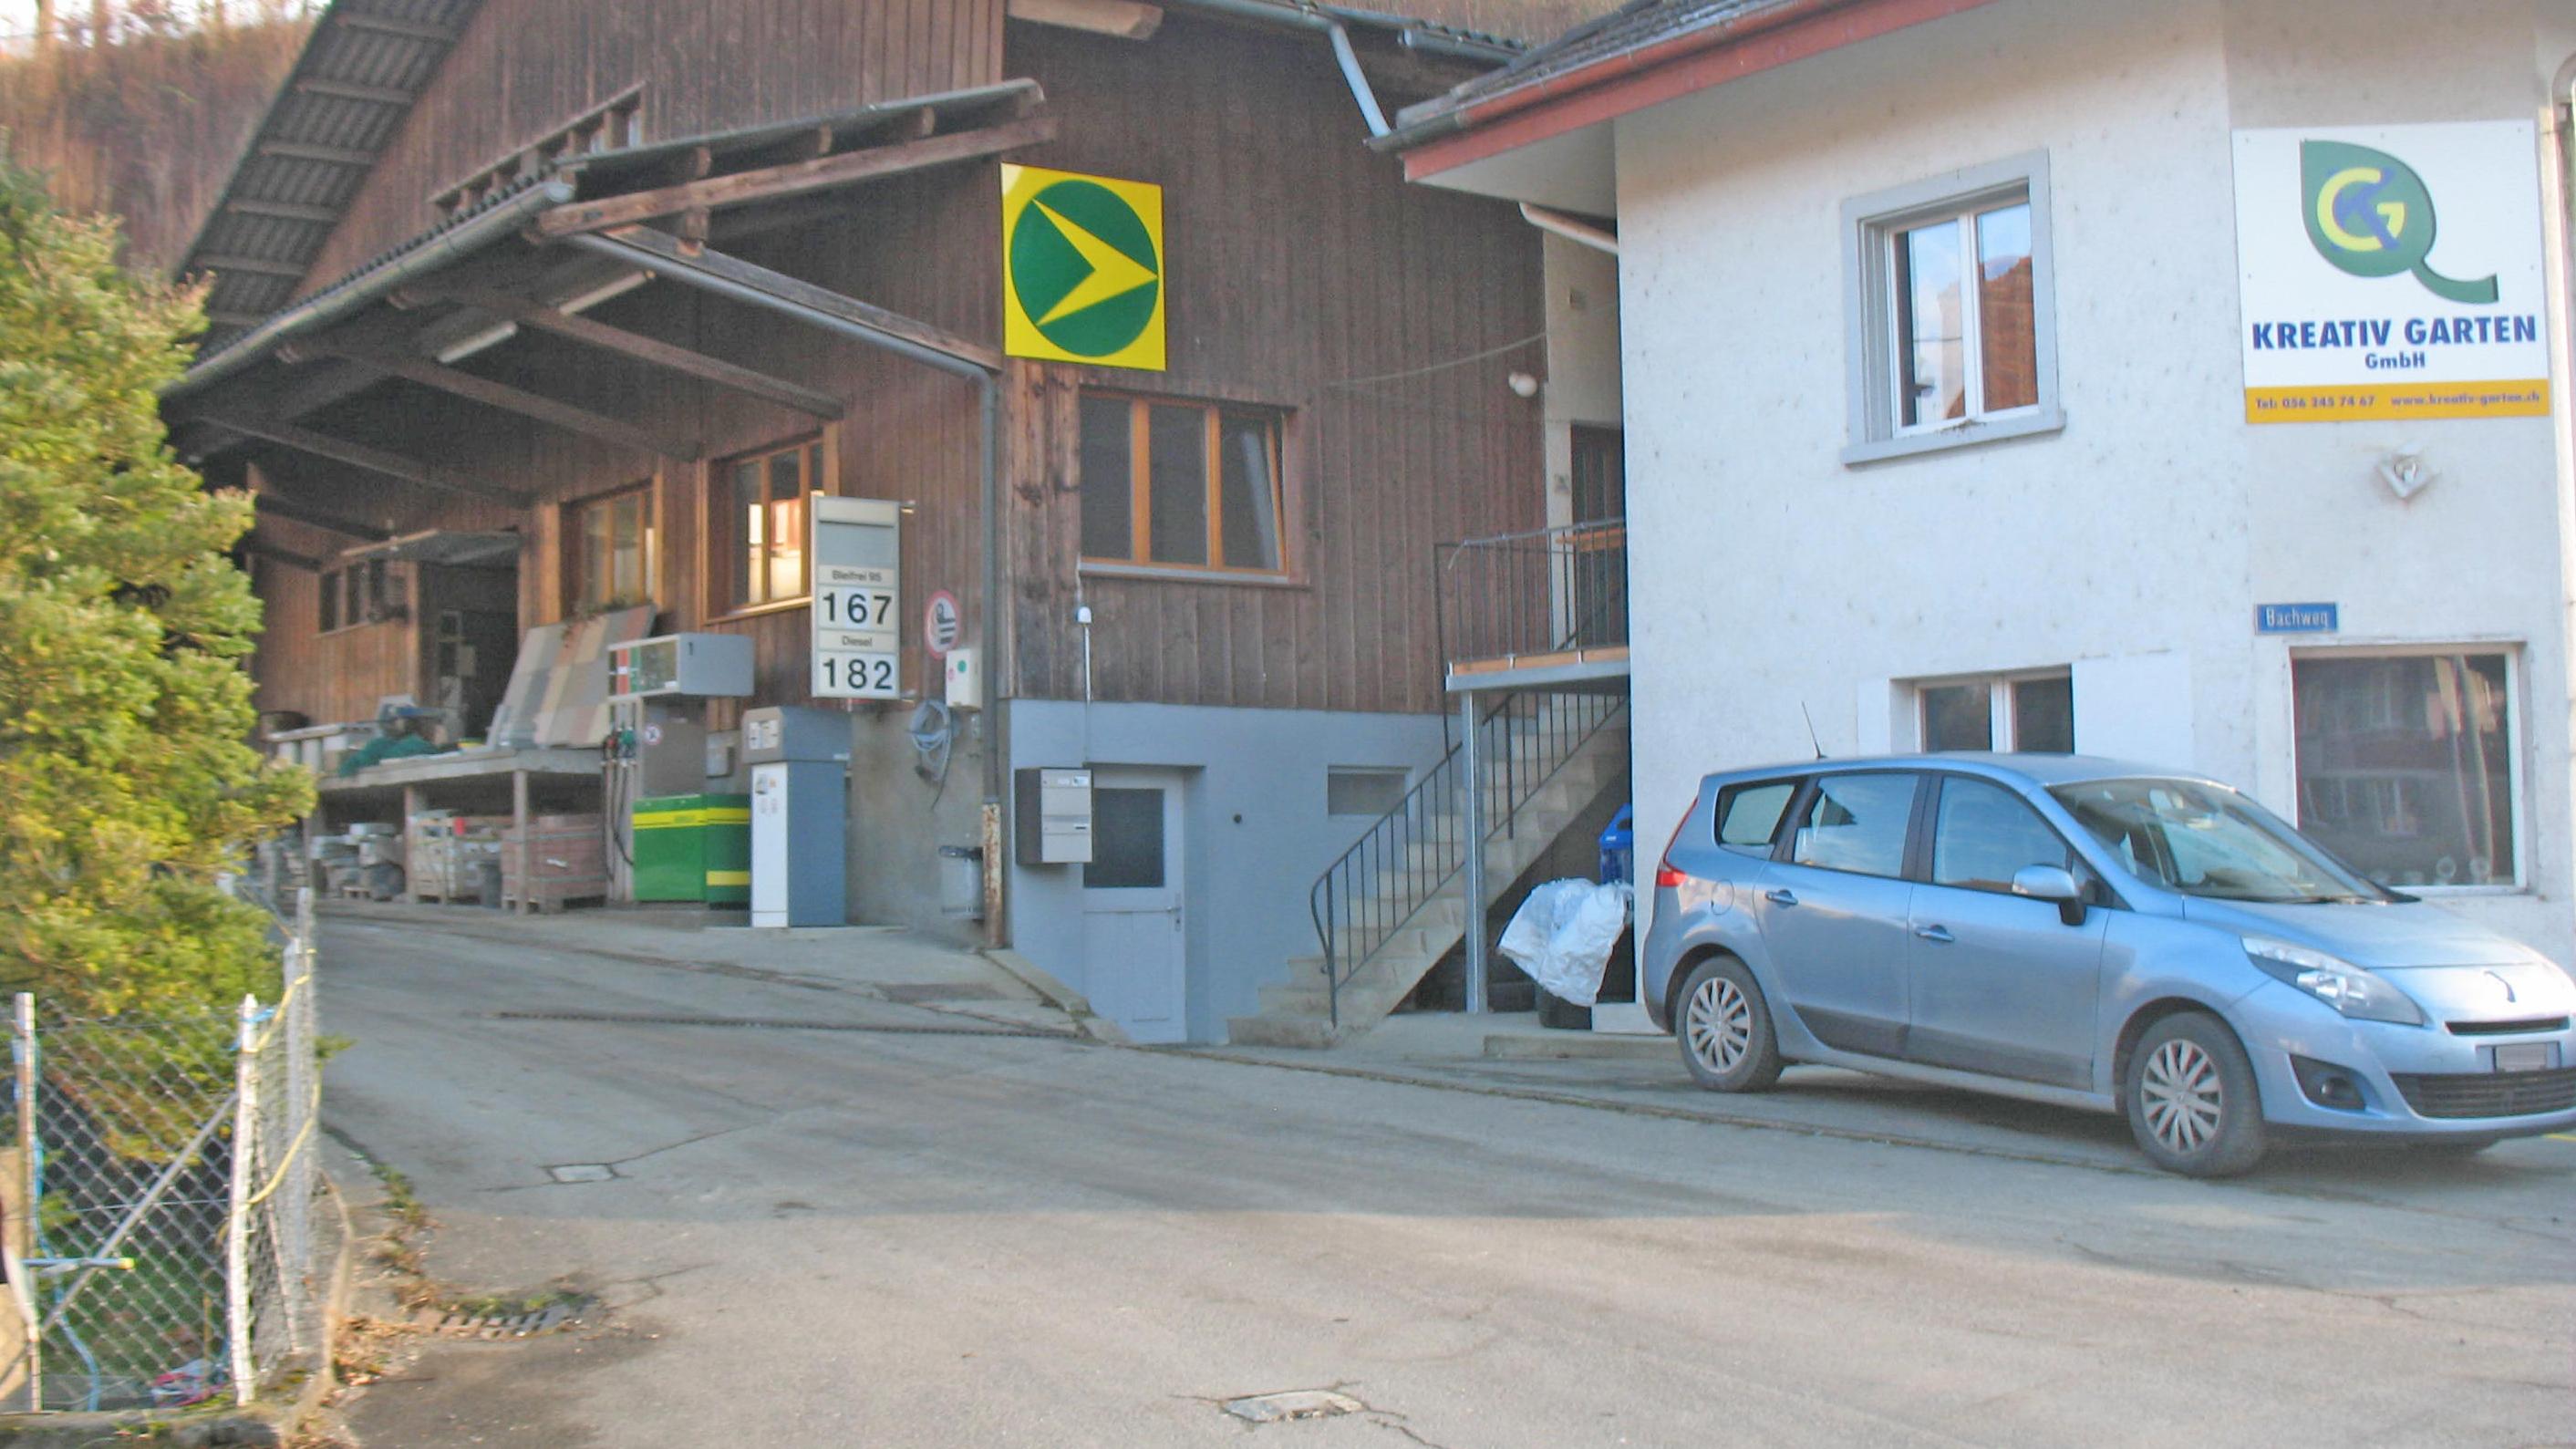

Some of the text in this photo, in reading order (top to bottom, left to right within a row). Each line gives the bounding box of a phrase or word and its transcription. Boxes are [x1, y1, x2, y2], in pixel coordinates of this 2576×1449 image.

[2251, 316, 2537, 350] KREATIV GARTEN
[2364, 351, 2426, 369] GmbH
[822, 592, 892, 625] 167
[2266, 606, 2328, 627] Bachweg
[842, 635, 873, 647] Diesel
[822, 657, 893, 689] 182
